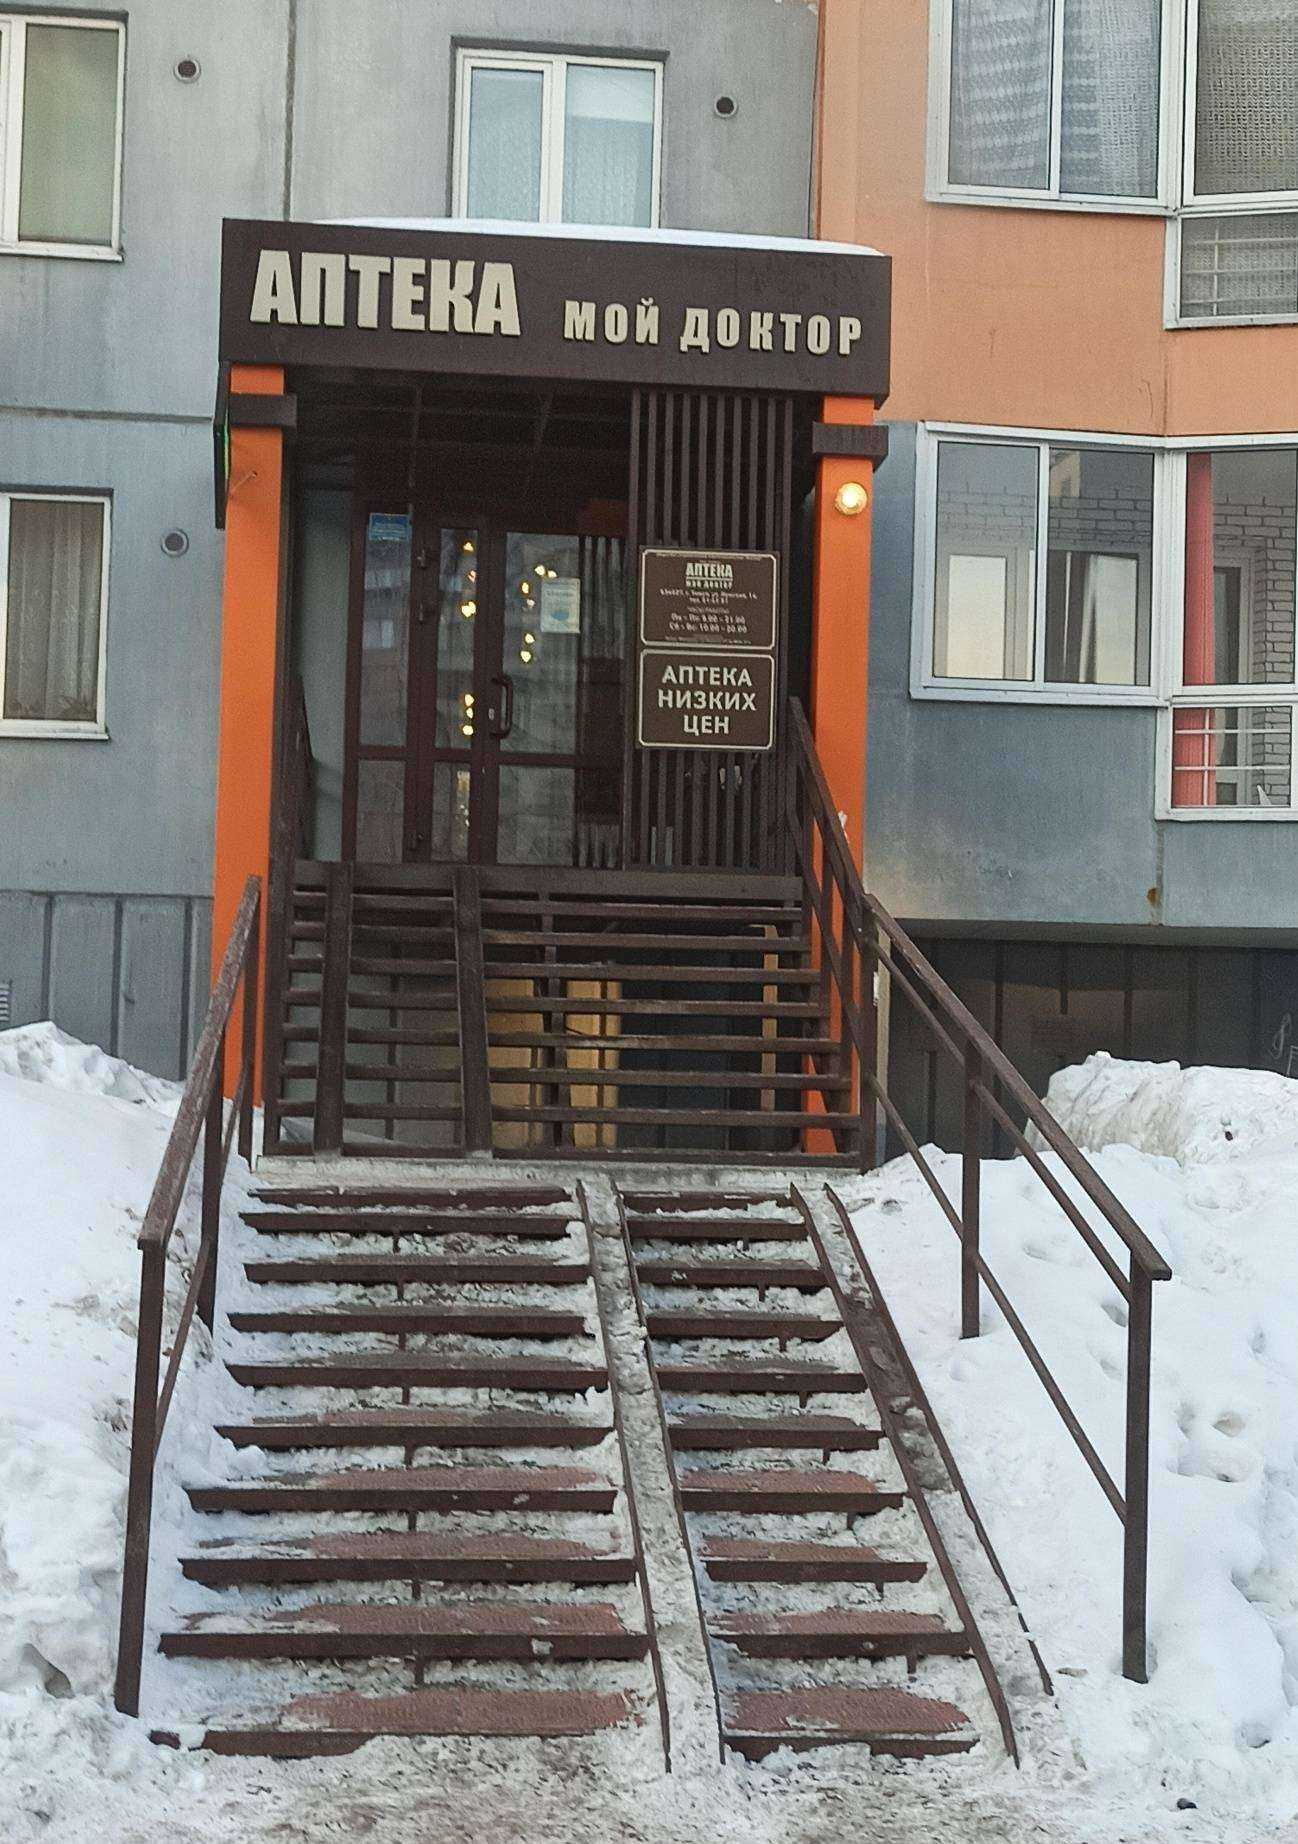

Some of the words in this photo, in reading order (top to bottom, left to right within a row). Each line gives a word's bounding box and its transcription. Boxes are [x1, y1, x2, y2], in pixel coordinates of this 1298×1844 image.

[250, 249, 521, 337] АПТЕКА
[563, 297, 659, 345] МОЙ
[679, 307, 862, 356] ДОКТОР
[686, 562, 733, 577] АПТЕКА
[662, 665, 752, 687] АПТЕКА
[658, 689, 757, 711] НИЗКИХ
[683, 715, 730, 736] ЦЕН
